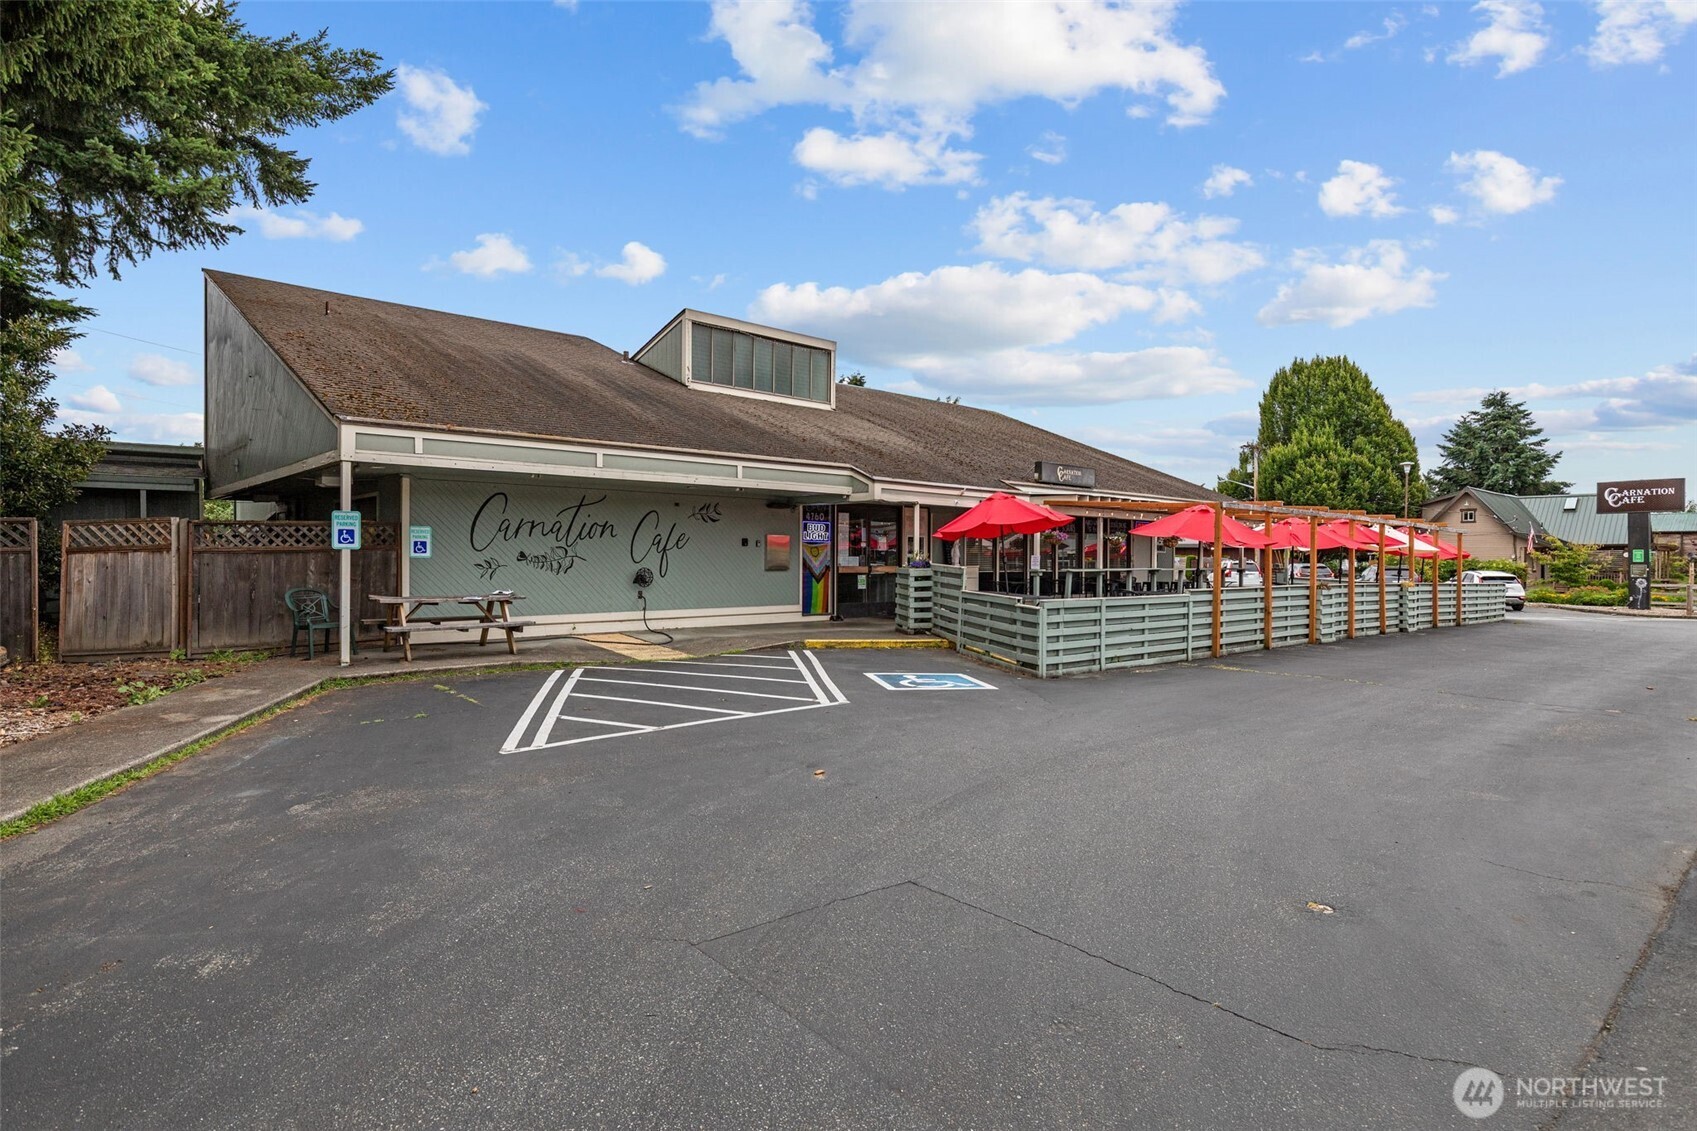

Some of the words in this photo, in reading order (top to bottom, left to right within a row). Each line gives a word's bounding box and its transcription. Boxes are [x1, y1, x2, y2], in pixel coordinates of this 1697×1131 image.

[1604, 487, 1675, 501] CARNATION
[1608, 493, 1645, 508] CAFE
[807, 523, 826, 532] BUD
[470, 492, 617, 552] Carnation
[630, 510, 691, 578] Cafe
[803, 531, 829, 541] LIGHT
